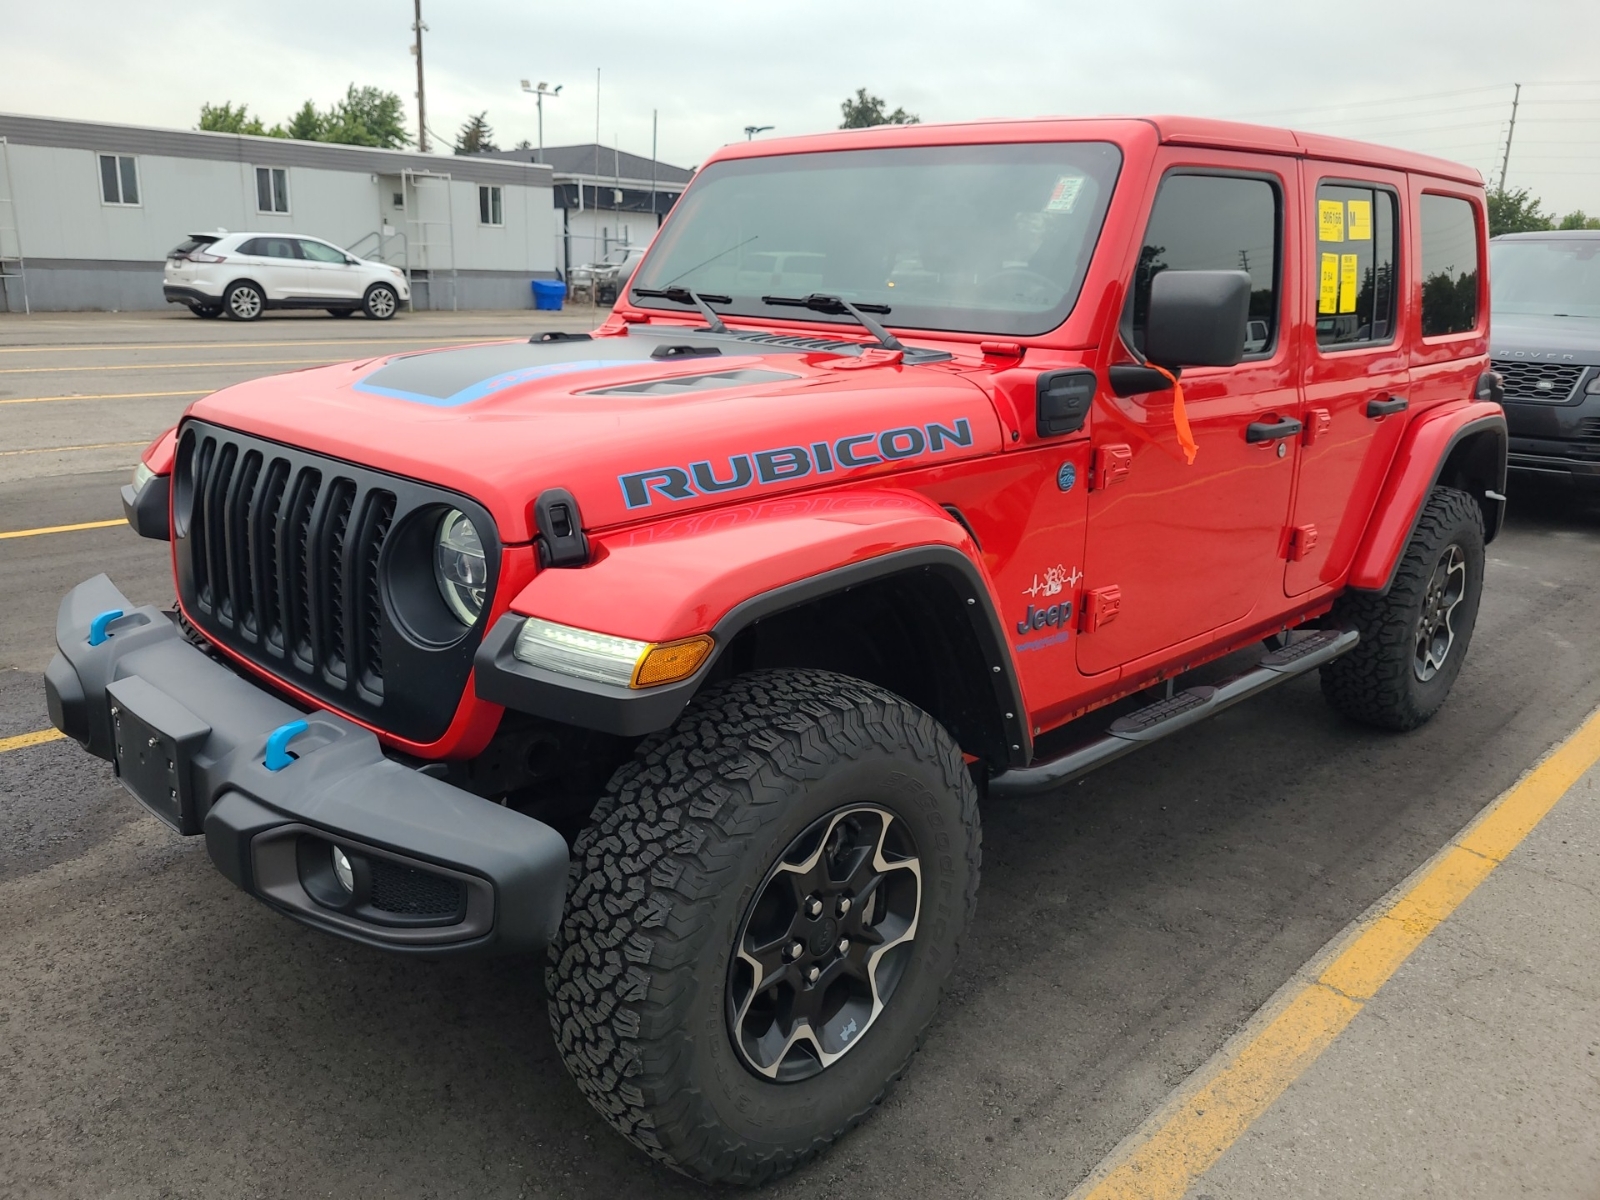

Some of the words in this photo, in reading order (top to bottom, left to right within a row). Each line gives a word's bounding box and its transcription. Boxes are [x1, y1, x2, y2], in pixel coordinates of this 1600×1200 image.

[1349, 211, 1356, 227] M
[1499, 350, 1574, 360] ROVER
[617, 418, 973, 509] RUBICON
[1017, 600, 1073, 635] Jeep
